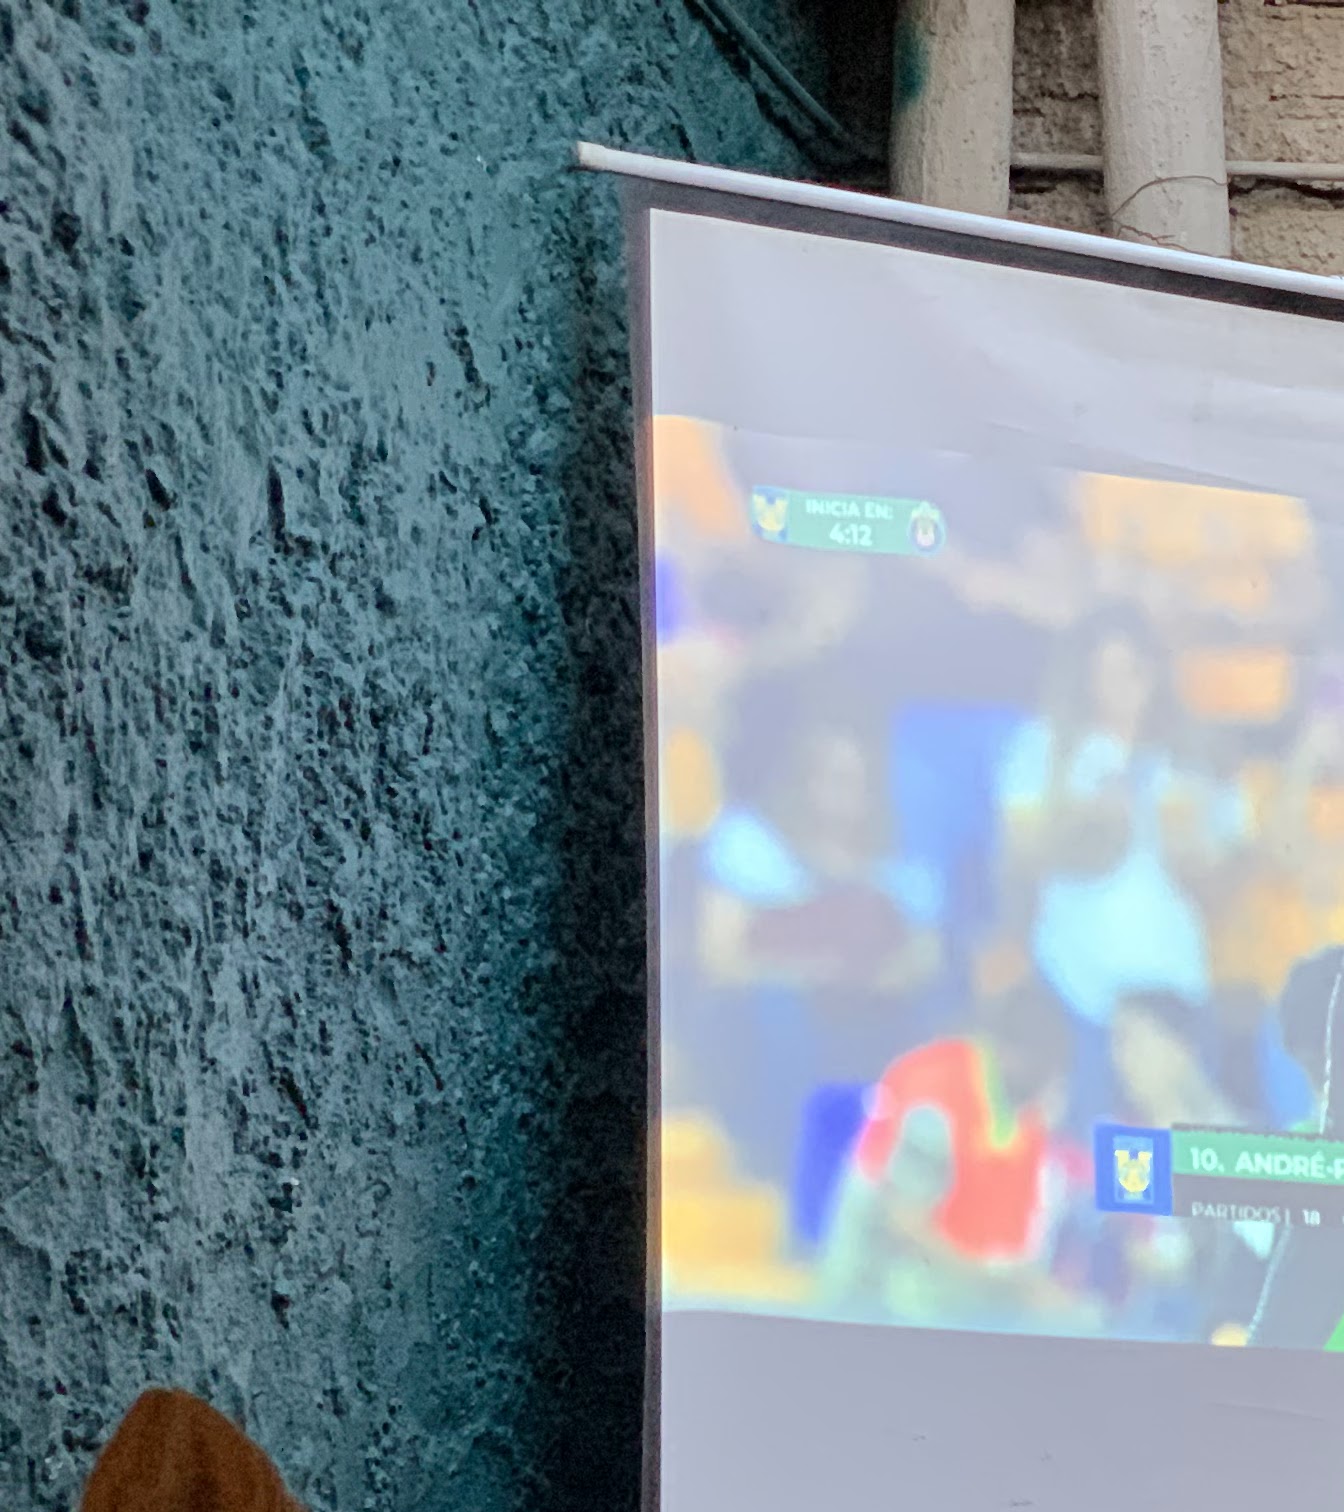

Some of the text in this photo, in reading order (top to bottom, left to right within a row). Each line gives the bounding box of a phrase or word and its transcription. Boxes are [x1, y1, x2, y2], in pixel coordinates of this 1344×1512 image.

[805, 498, 894, 520] INICIA EN:
[829, 522, 874, 547] 4:12
[1190, 1147, 1225, 1173] 10.
